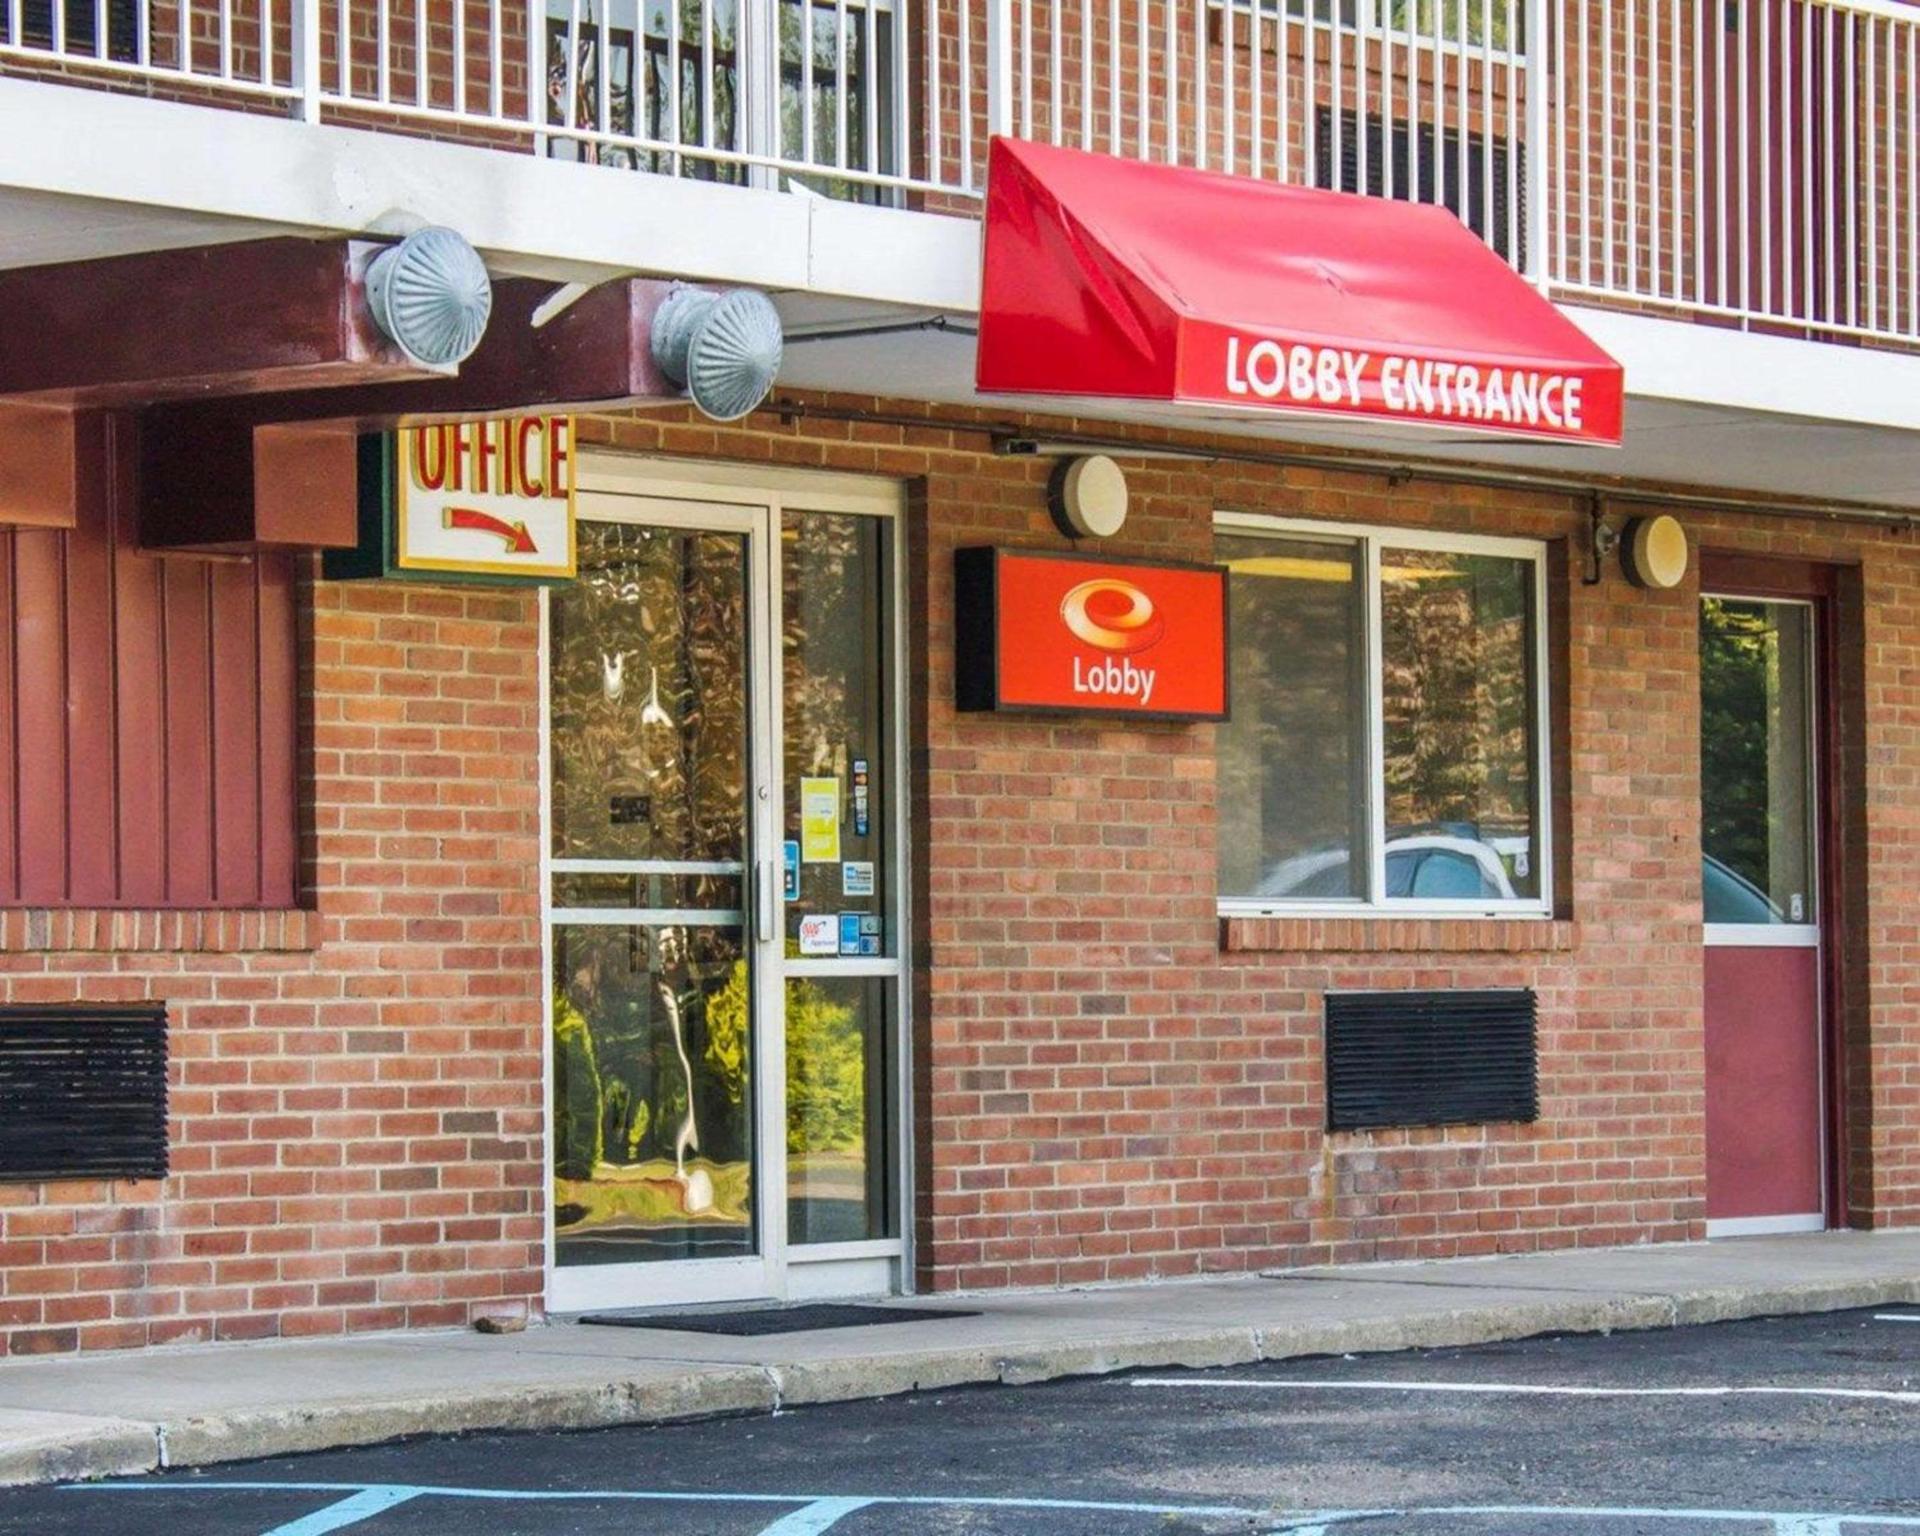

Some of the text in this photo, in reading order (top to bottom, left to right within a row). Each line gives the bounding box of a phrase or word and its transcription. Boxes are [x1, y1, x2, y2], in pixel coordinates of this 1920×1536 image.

[1225, 336, 1584, 430] LOBBY ENTRANCE
[412, 416, 569, 499] OFFICE
[1073, 656, 1156, 706] Lobby
